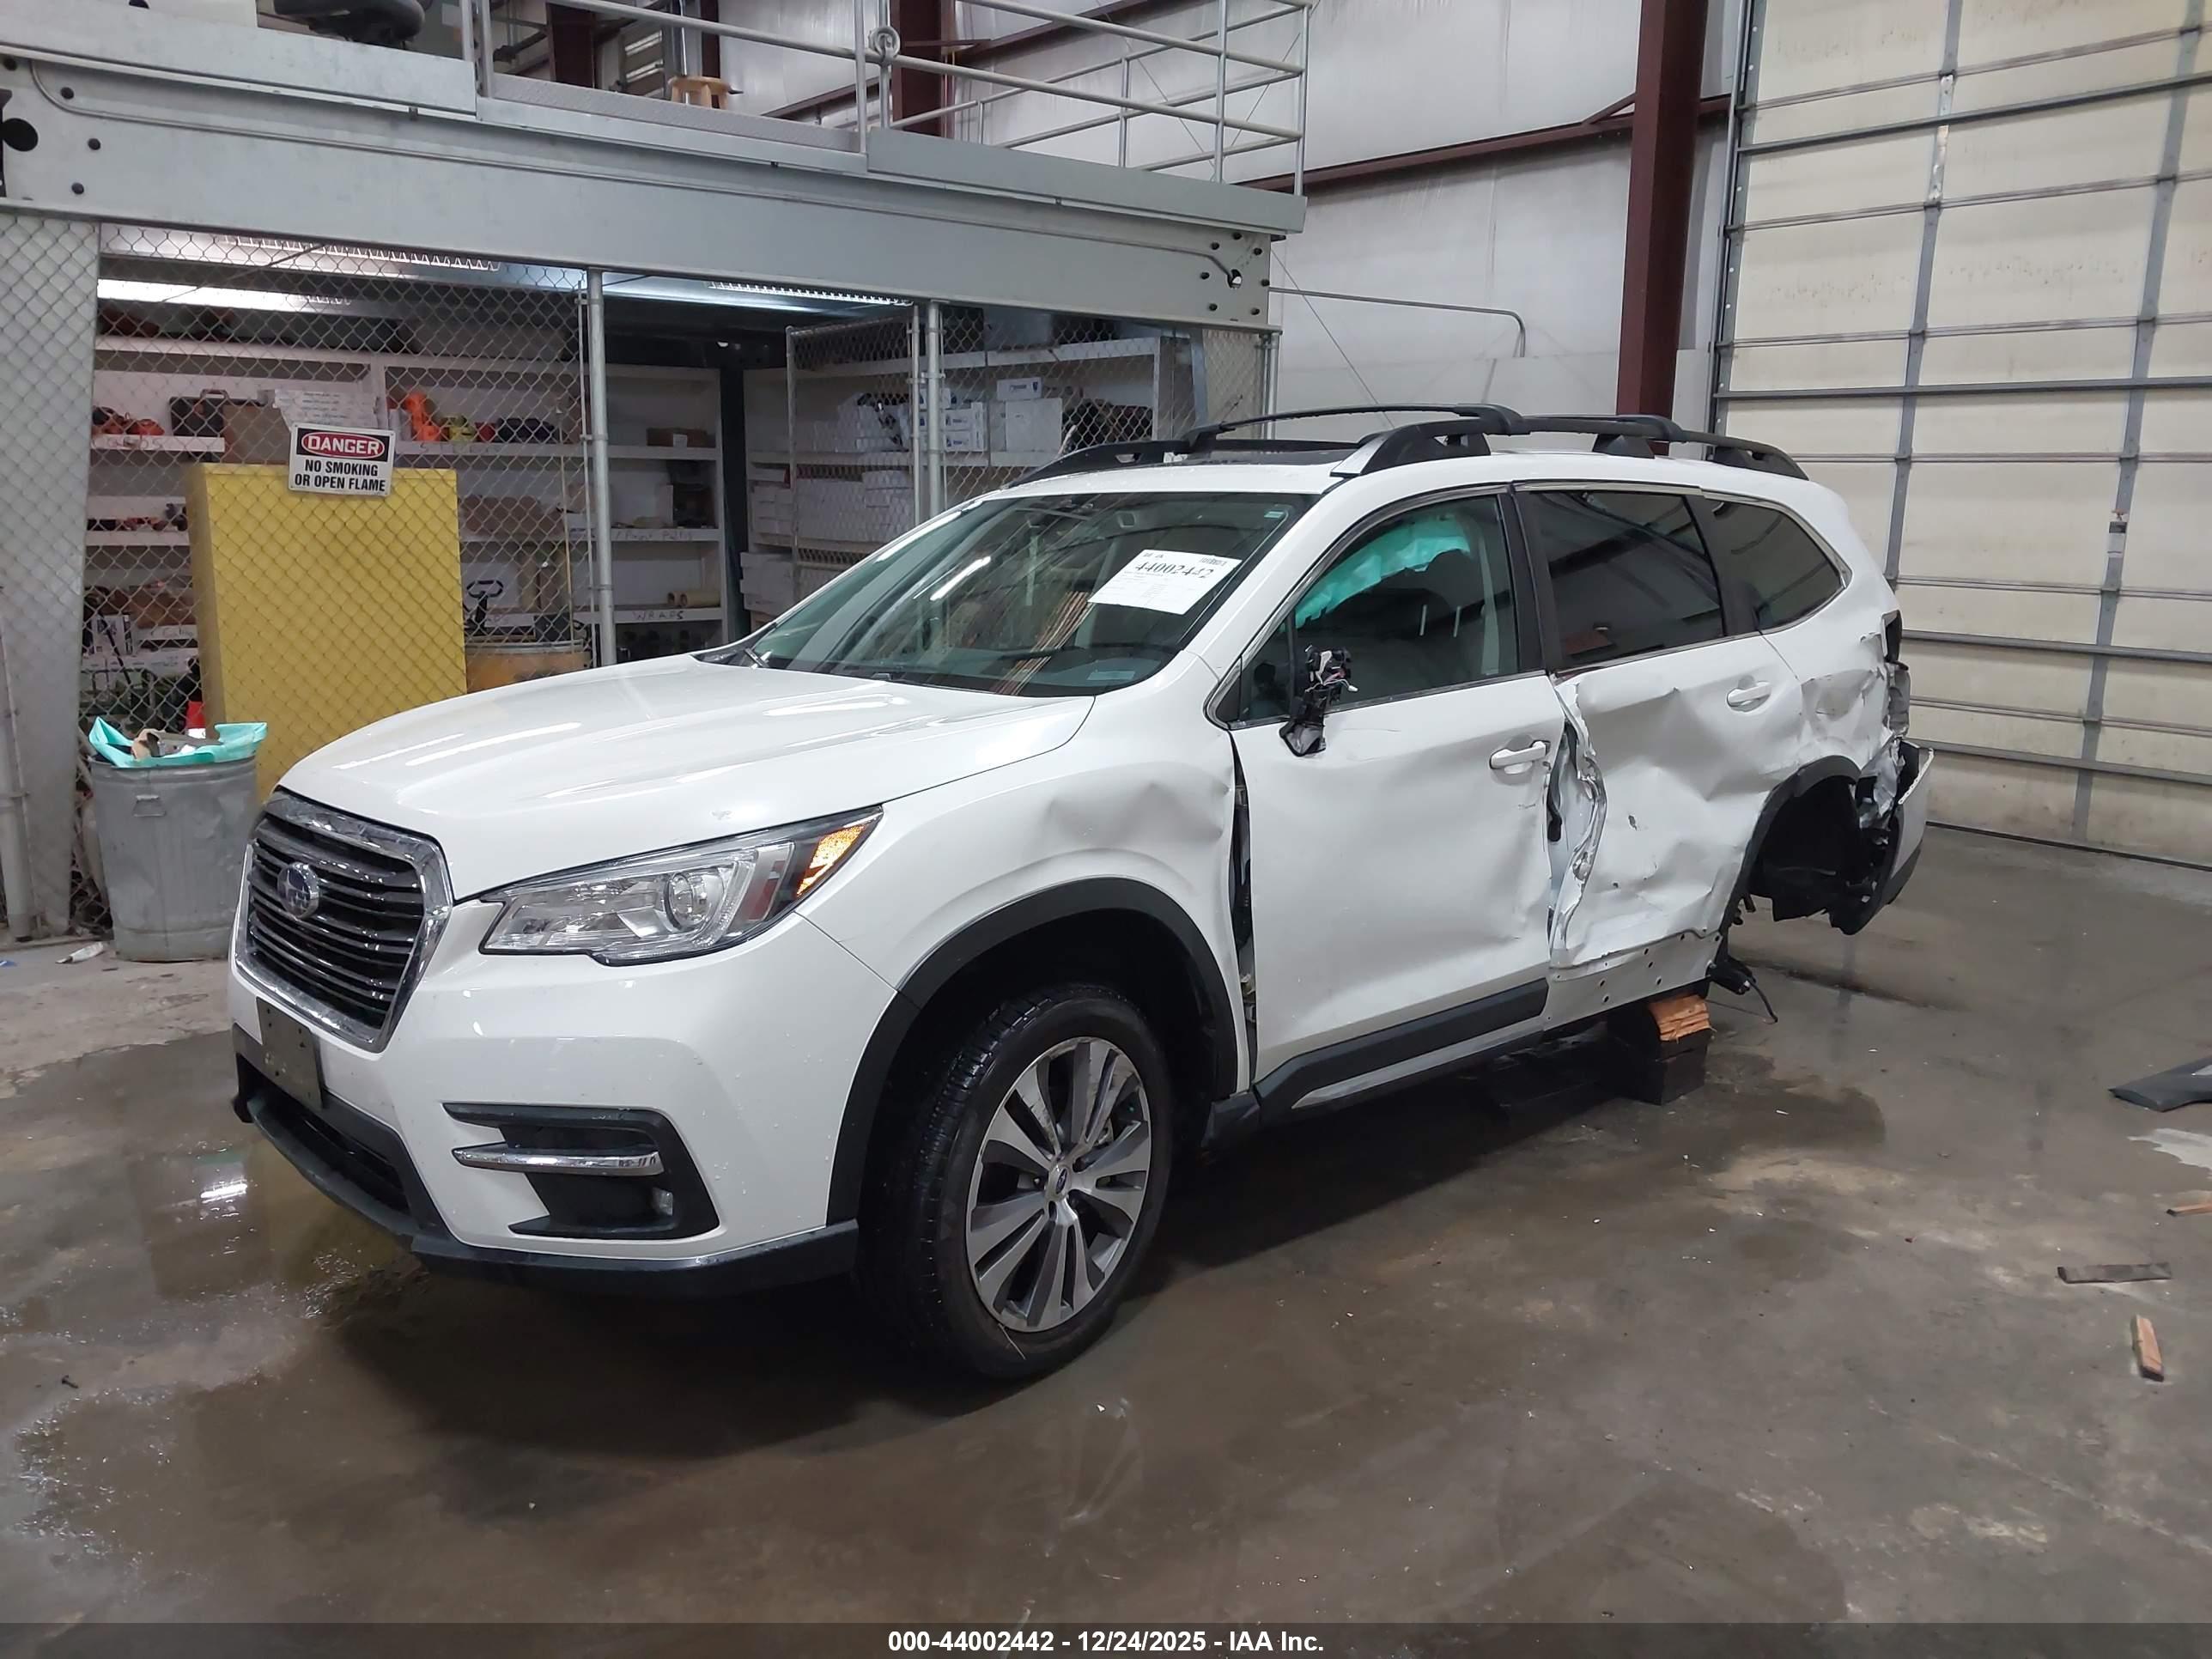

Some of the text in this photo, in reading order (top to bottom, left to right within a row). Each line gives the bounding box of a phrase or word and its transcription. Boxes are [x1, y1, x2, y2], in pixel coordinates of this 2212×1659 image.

[307, 435, 380, 454] DANGER
[305, 459, 379, 477] NO SMOKING
[295, 473, 386, 492] OR OPEN FLAME
[1135, 561, 1214, 579] 44002442
